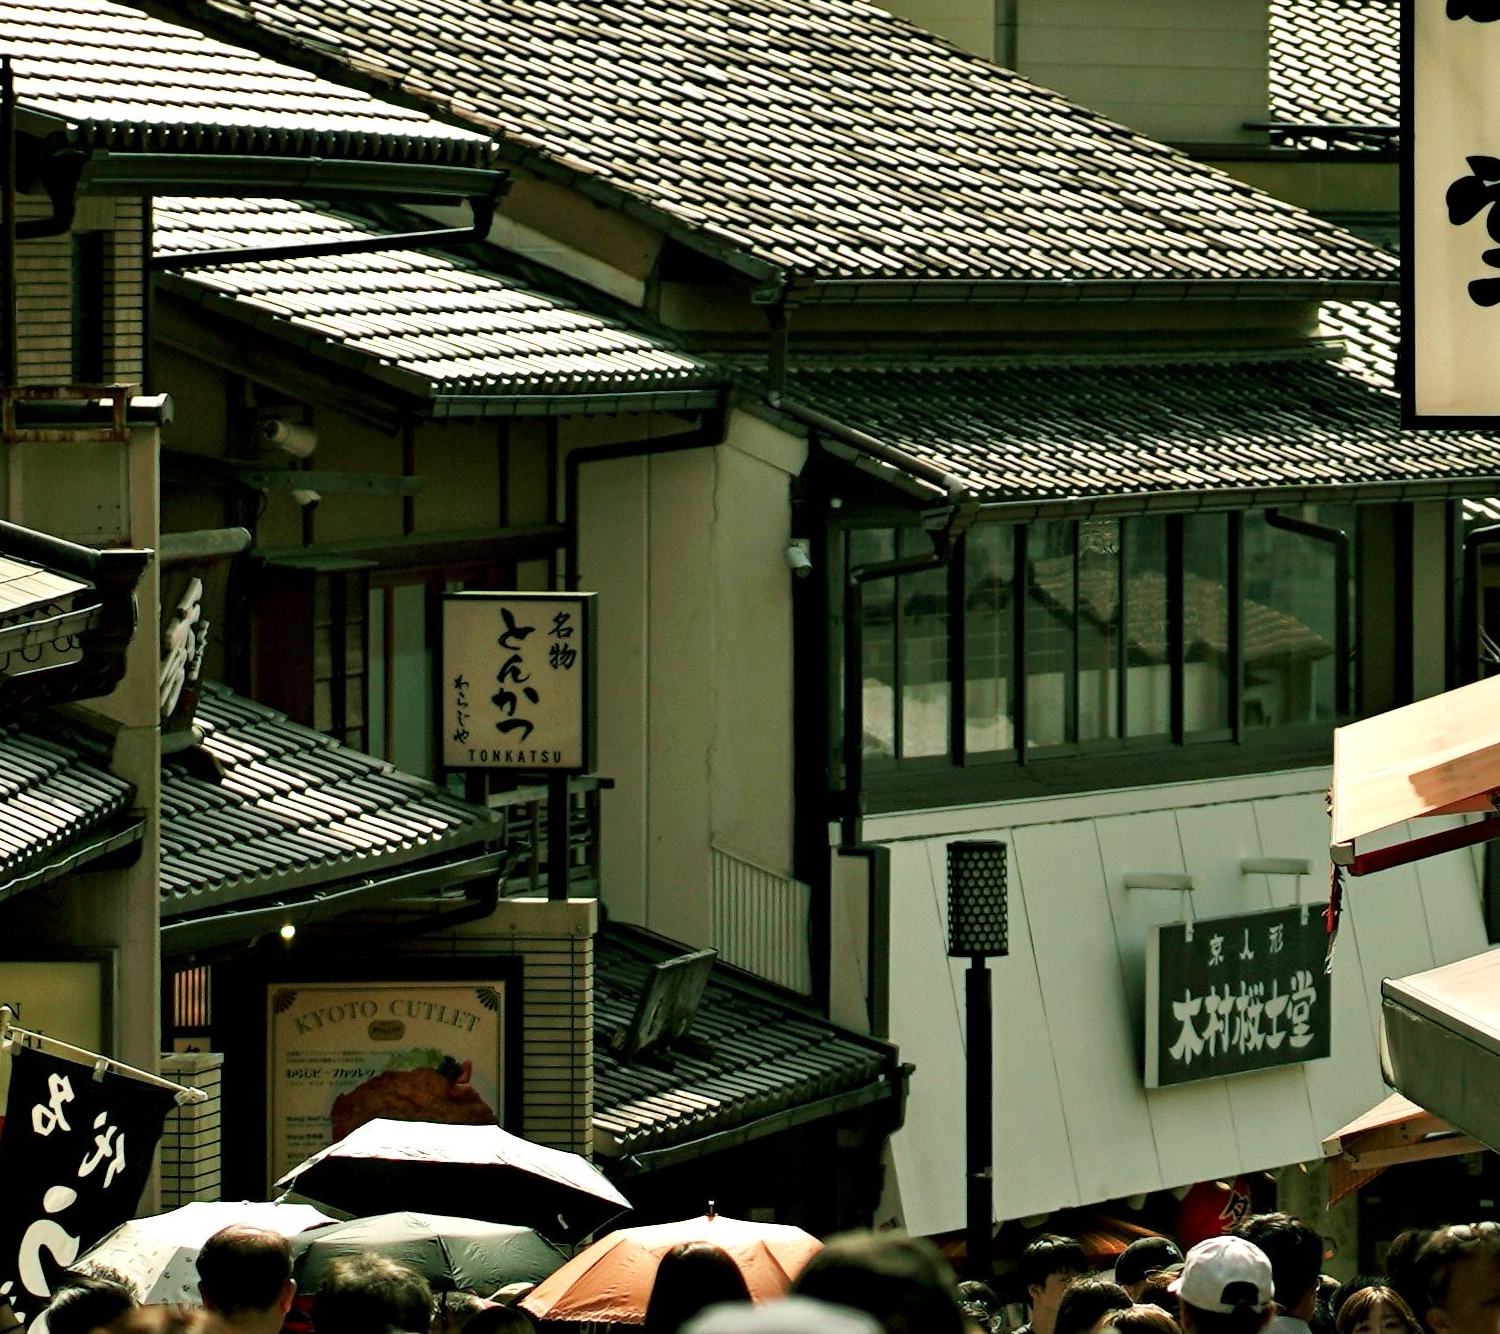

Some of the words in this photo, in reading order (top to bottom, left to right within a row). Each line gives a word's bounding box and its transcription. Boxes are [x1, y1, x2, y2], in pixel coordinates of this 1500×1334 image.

[548, 611, 578, 671] 名物
[491, 607, 539, 742] とんかつ
[468, 749, 562, 764] TONKATSU
[1208, 923, 1285, 968] 京人形
[294, 999, 379, 1034] KYOTO
[389, 999, 482, 1033] CUTLET
[1168, 969, 1318, 1066] 木村桜士堂
